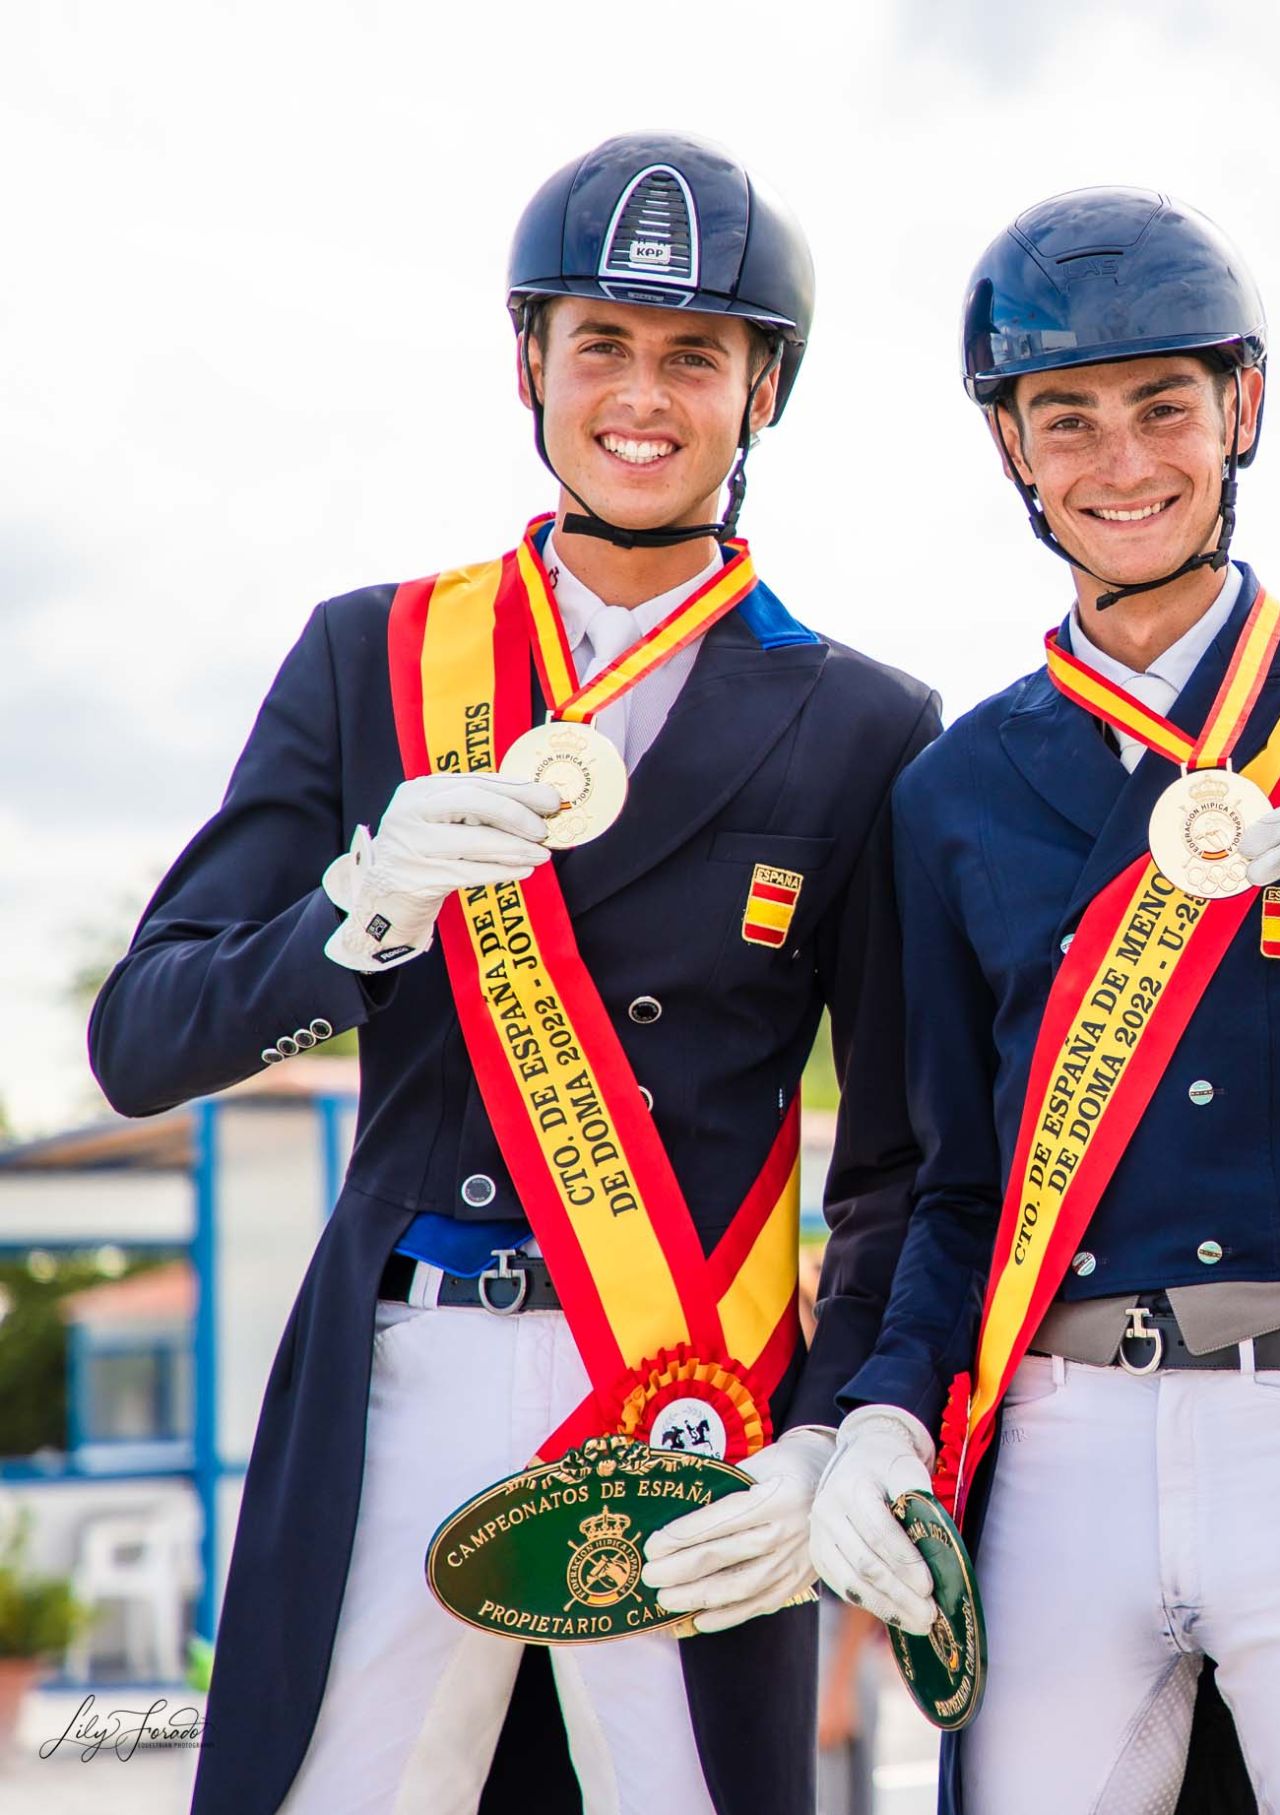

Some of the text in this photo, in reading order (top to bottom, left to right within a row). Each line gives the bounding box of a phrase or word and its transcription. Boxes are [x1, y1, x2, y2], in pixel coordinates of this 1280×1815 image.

[1063, 259, 1118, 280] LAS
[465, 702, 493, 773] ETES
[534, 756, 553, 783] RACION
[556, 754, 583, 767] HIPICA
[1184, 808, 1203, 855] FEDERACION
[1200, 802, 1229, 812] HIPICA
[473, 909, 501, 957] DE
[483, 959, 550, 1083] ESPAÑA
[534, 995, 581, 1066] 2022
[1014, 871, 1176, 1267] CTO. DE ESPAÑA DE MENO
[1047, 1147, 1080, 1196] DE
[1069, 1053, 1127, 1148] DOMA
[1115, 975, 1162, 1049] 2022
[530, 1084, 568, 1133] DE
[565, 1068, 619, 1168] DOMA
[552, 1135, 596, 1207] CTO.
[600, 1169, 639, 1218] DE
[447, 1480, 713, 1569] CAMPEONATOS DE ESPAÑA
[595, 1539, 627, 1553] HIPICA
[478, 1600, 612, 1635] PROPIETARIO
[934, 1675, 971, 1717] PROPIETARIO
